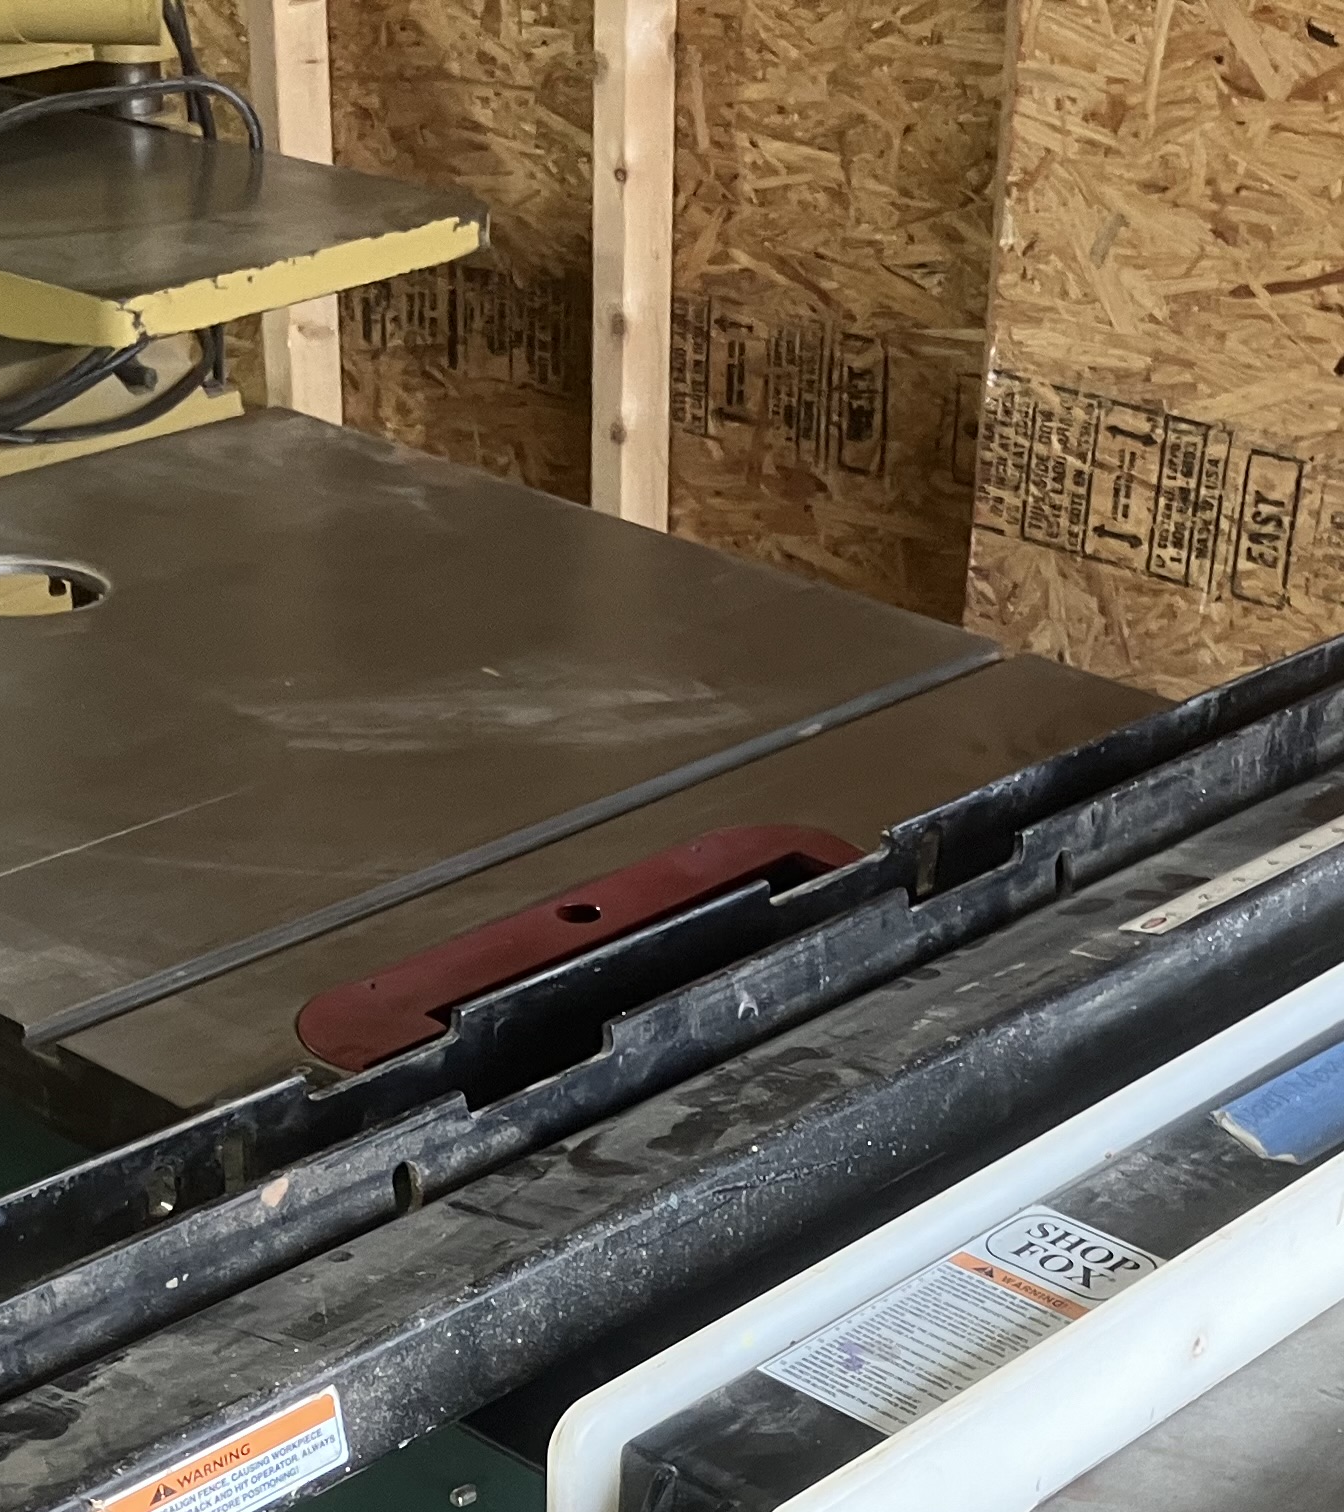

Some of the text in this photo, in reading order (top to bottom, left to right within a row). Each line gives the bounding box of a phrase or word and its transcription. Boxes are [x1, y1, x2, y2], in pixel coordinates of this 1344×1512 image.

[1243, 488, 1288, 569] EAST
[1010, 1240, 1109, 1290] FOX
[1025, 1222, 1140, 1273] SHOP
[176, 1442, 251, 1489] WARNING
[213, 1487, 233, 1504] AND
[233, 1478, 249, 1493] HIT
[300, 1433, 336, 1458] ALWAYS
[230, 1454, 270, 1482] CAUSING
[271, 1427, 323, 1461] WORKPIECE
